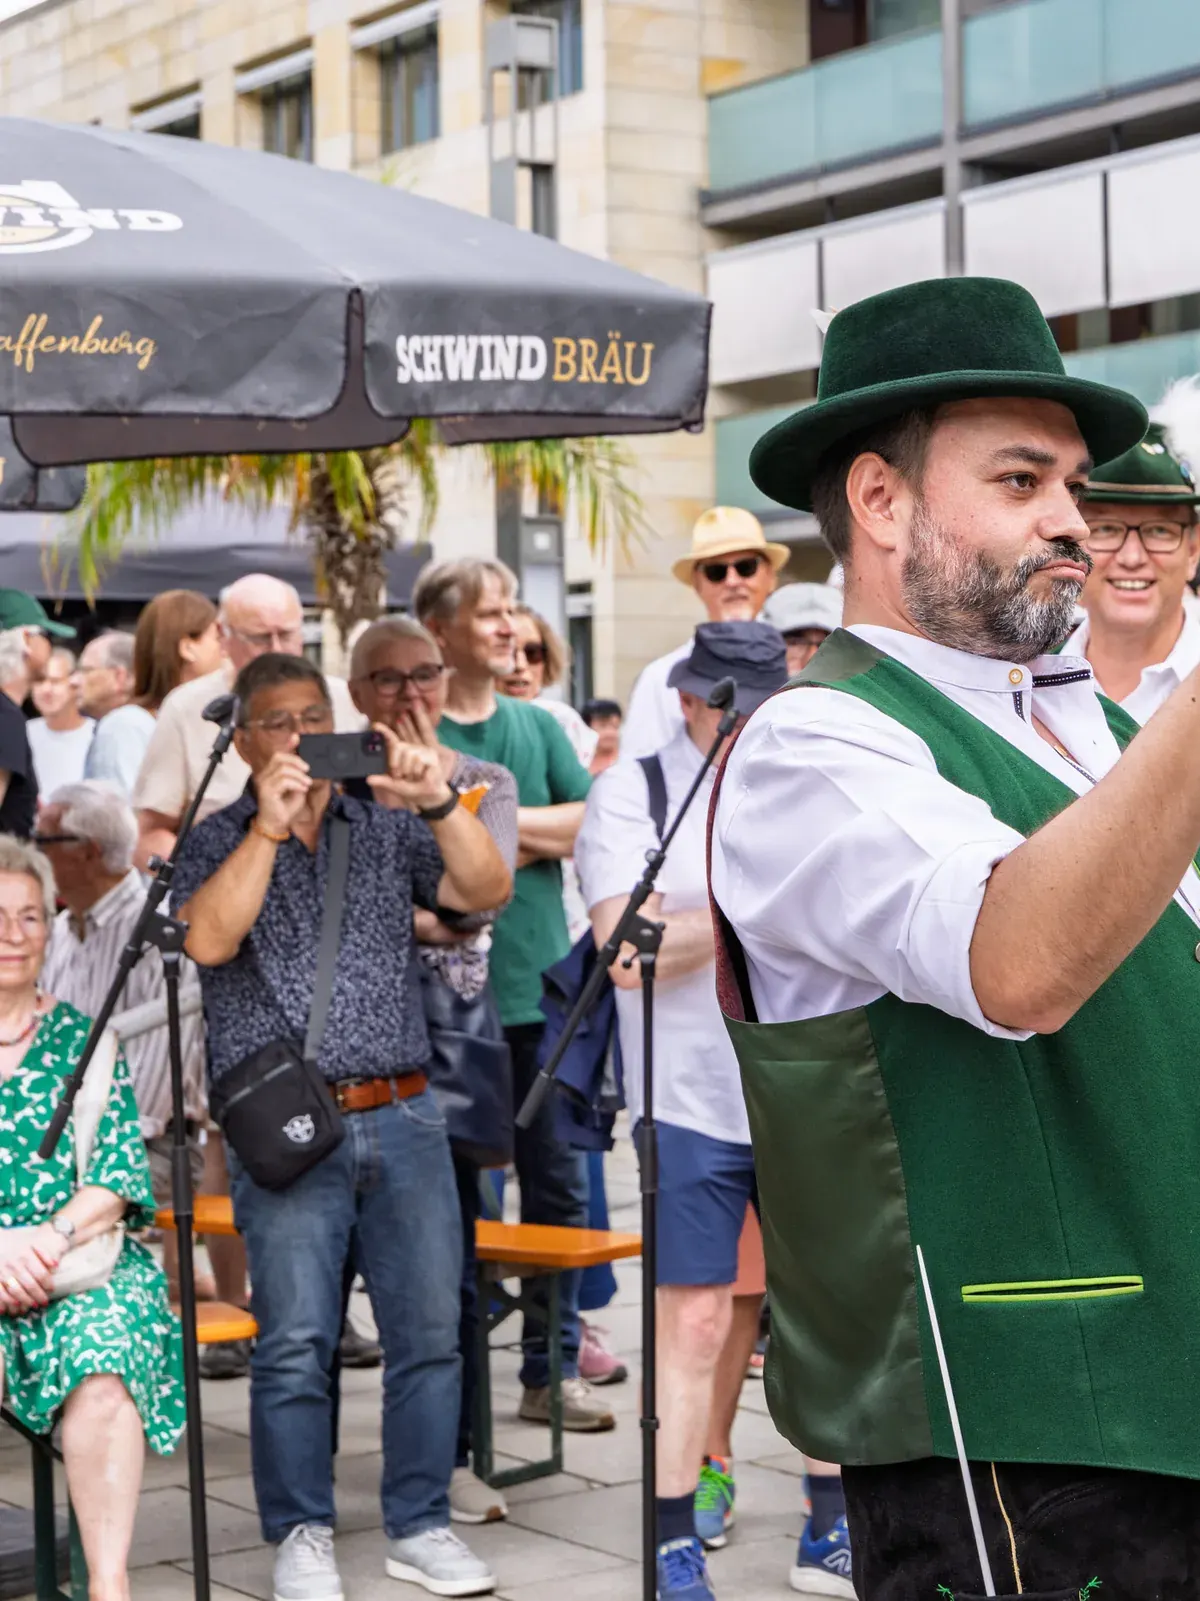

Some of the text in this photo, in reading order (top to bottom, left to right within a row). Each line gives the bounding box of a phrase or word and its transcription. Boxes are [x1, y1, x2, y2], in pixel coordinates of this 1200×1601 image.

[0, 206, 184, 231] IND
[395, 329, 655, 386] SCHWIND BRÄU
